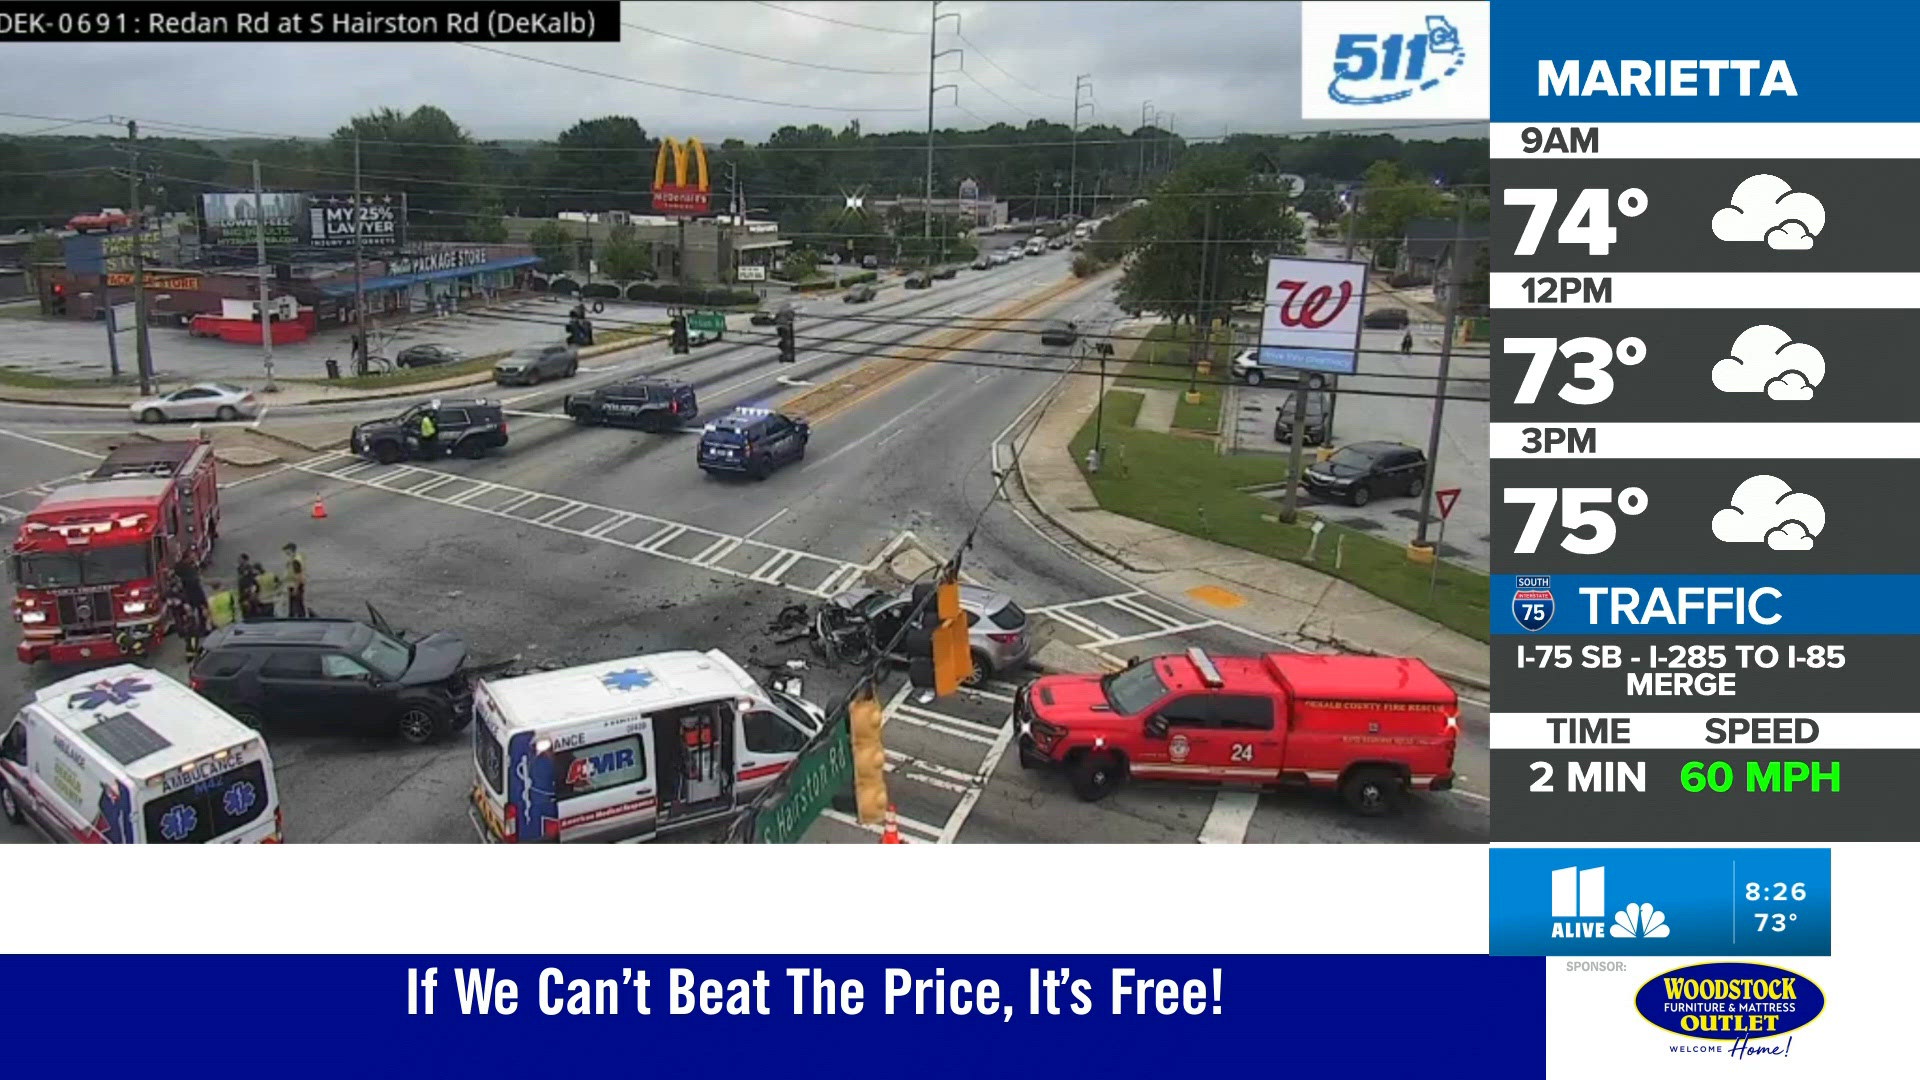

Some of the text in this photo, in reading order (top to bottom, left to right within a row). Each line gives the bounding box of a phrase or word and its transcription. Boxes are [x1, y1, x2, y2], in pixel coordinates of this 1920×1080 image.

[327, 206, 394, 220] MY 25%
[327, 221, 394, 233] LAWYER
[412, 251, 457, 274] PACKAGE
[458, 247, 487, 267] STORE
[1344, 702, 1381, 711] COUNTY
[1384, 703, 1406, 712] FIRE
[1231, 744, 1254, 762] 24
[163, 752, 245, 794] AMBULANCE
[566, 748, 634, 786] AMR
[776, 764, 829, 843] Hairston
[829, 738, 846, 778] Rd
